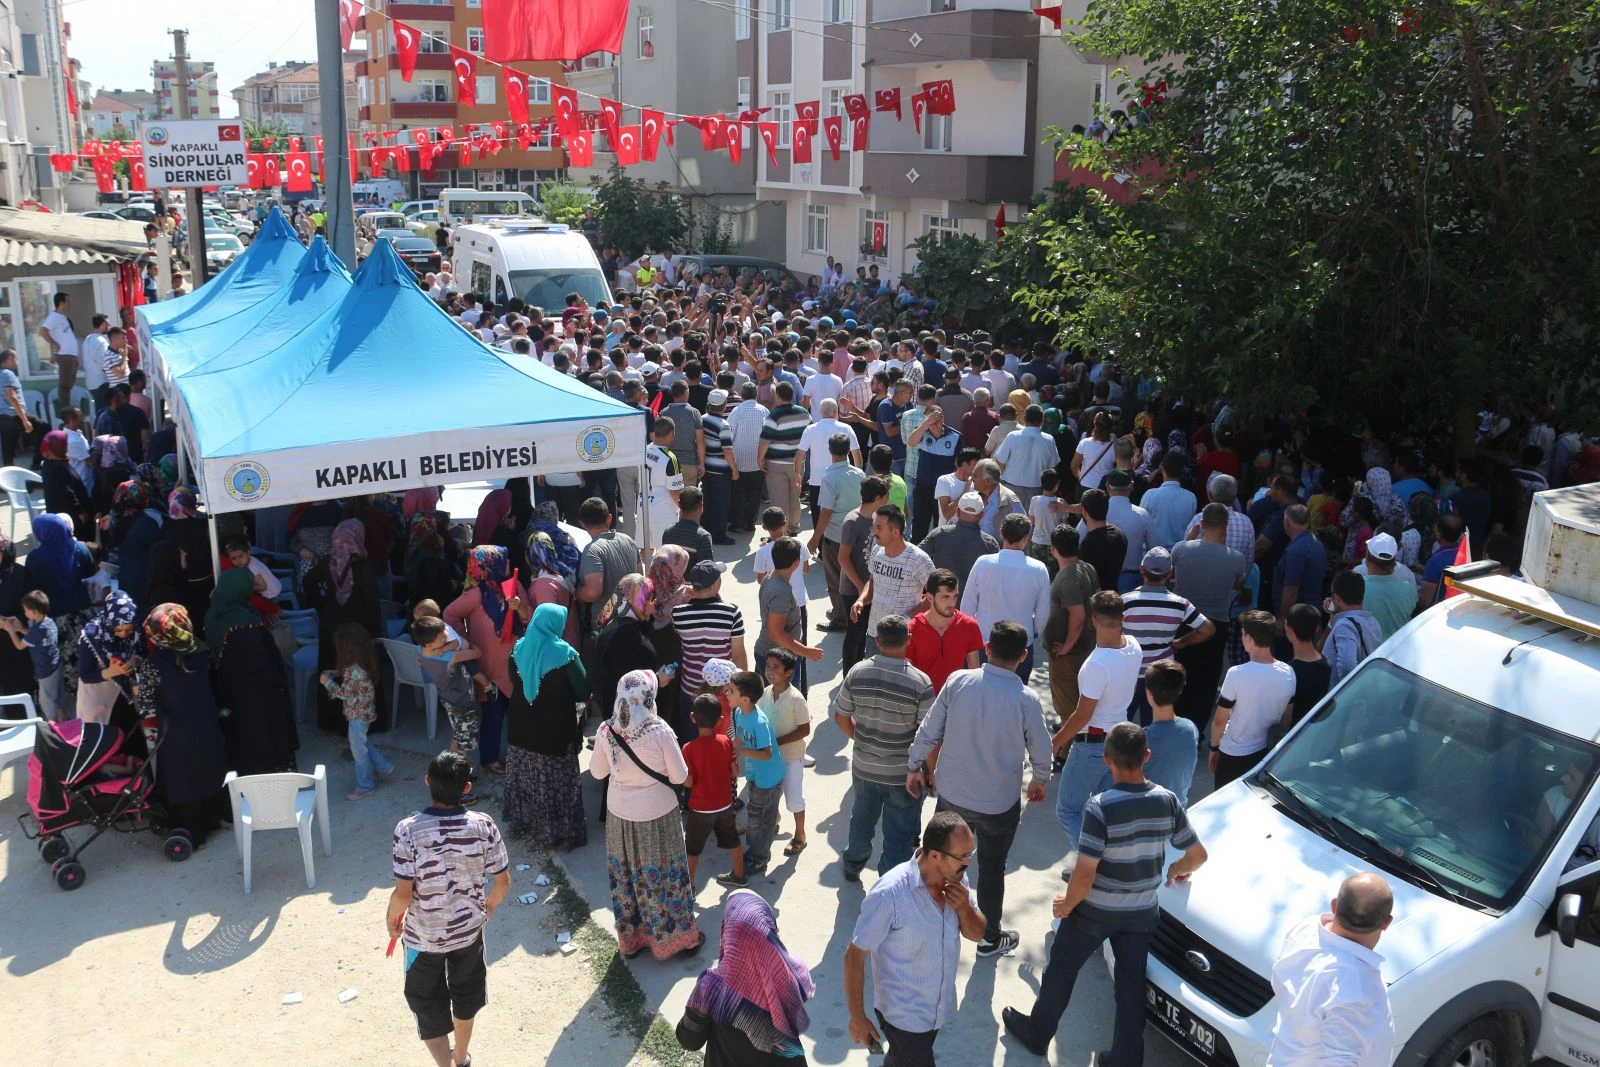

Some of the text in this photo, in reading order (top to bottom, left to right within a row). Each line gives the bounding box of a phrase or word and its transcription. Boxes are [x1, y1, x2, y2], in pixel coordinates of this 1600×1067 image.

[171, 143, 218, 152] KAPAKLI
[148, 153, 245, 168] SİNOPLULAR
[165, 167, 231, 183] DERNEĞİ
[315, 441, 537, 489] KAPAKLI BELEDİYESİ
[1165, 1000, 1180, 1024] TE
[1189, 1019, 1213, 1049] 702
